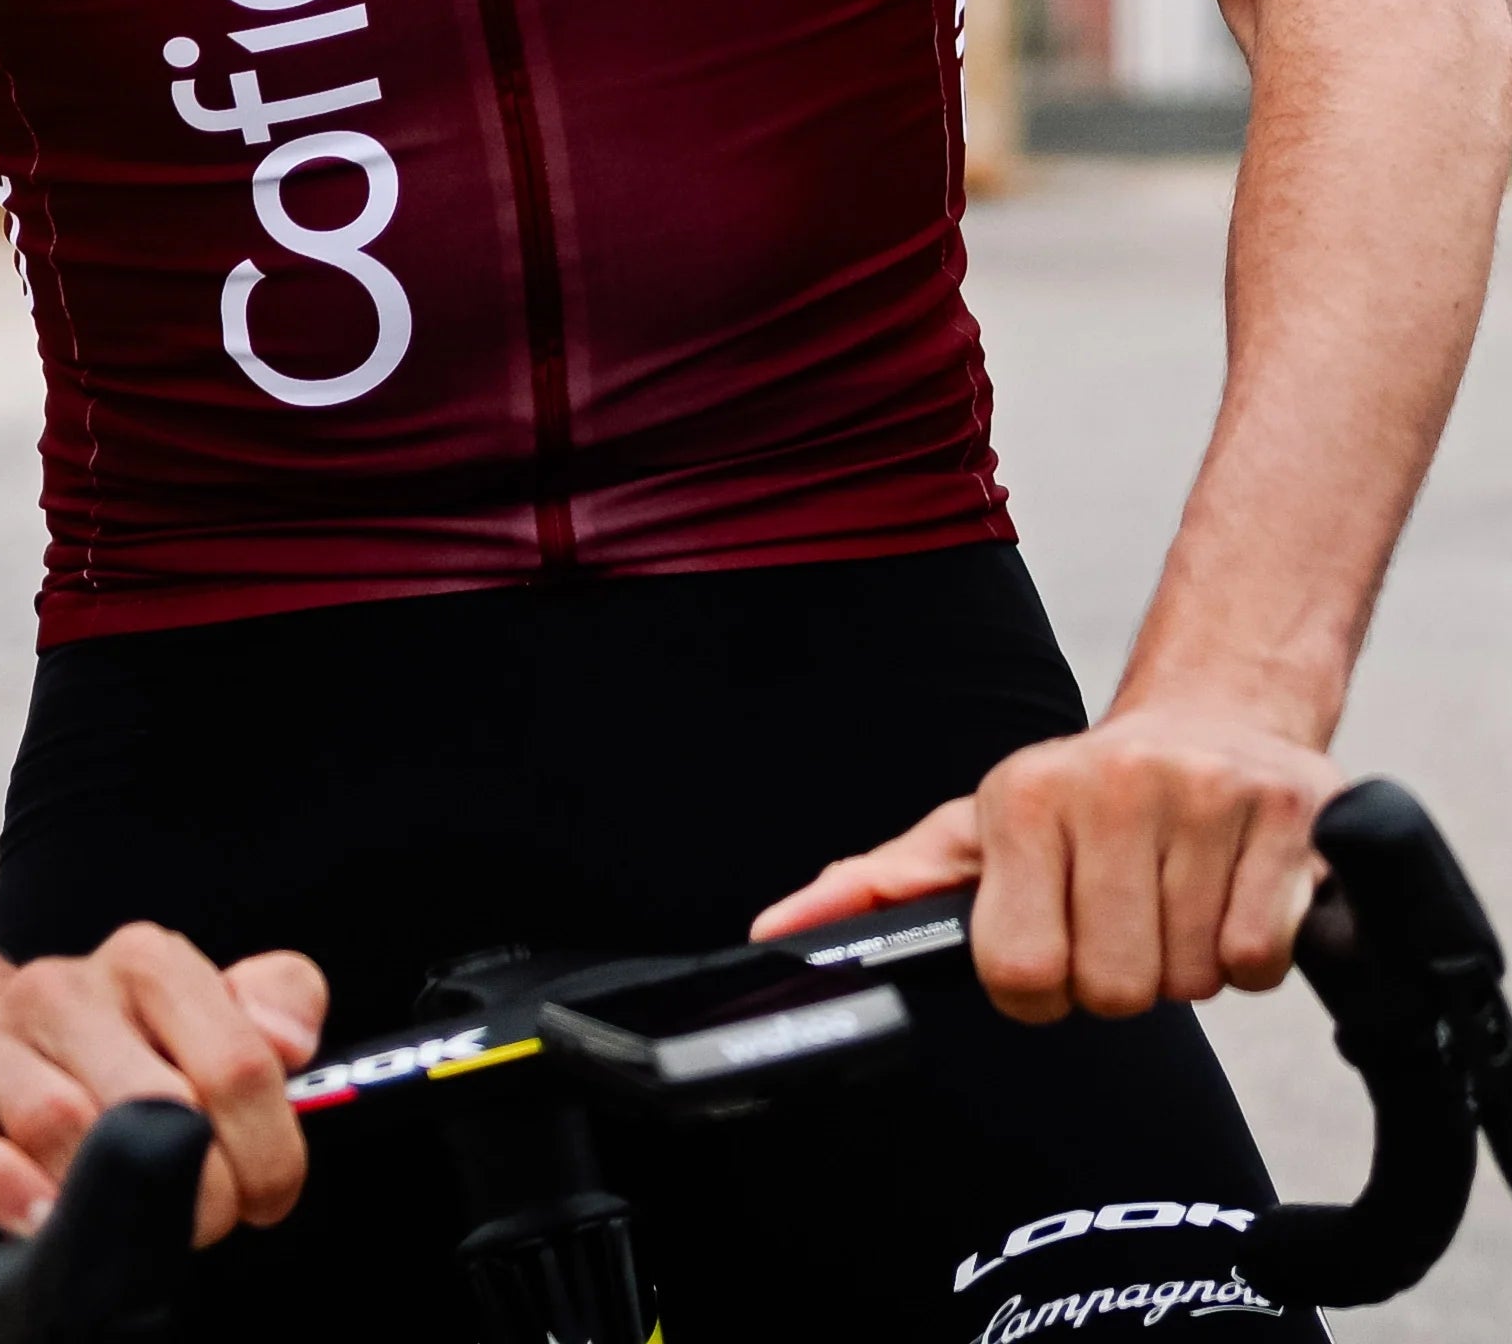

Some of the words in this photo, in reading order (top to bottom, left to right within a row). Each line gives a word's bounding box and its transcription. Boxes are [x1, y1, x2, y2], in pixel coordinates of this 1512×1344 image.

[285, 1025, 489, 1102] OOK
[953, 1201, 1256, 1293] LOOK
[969, 1265, 1284, 1344] Campagno
